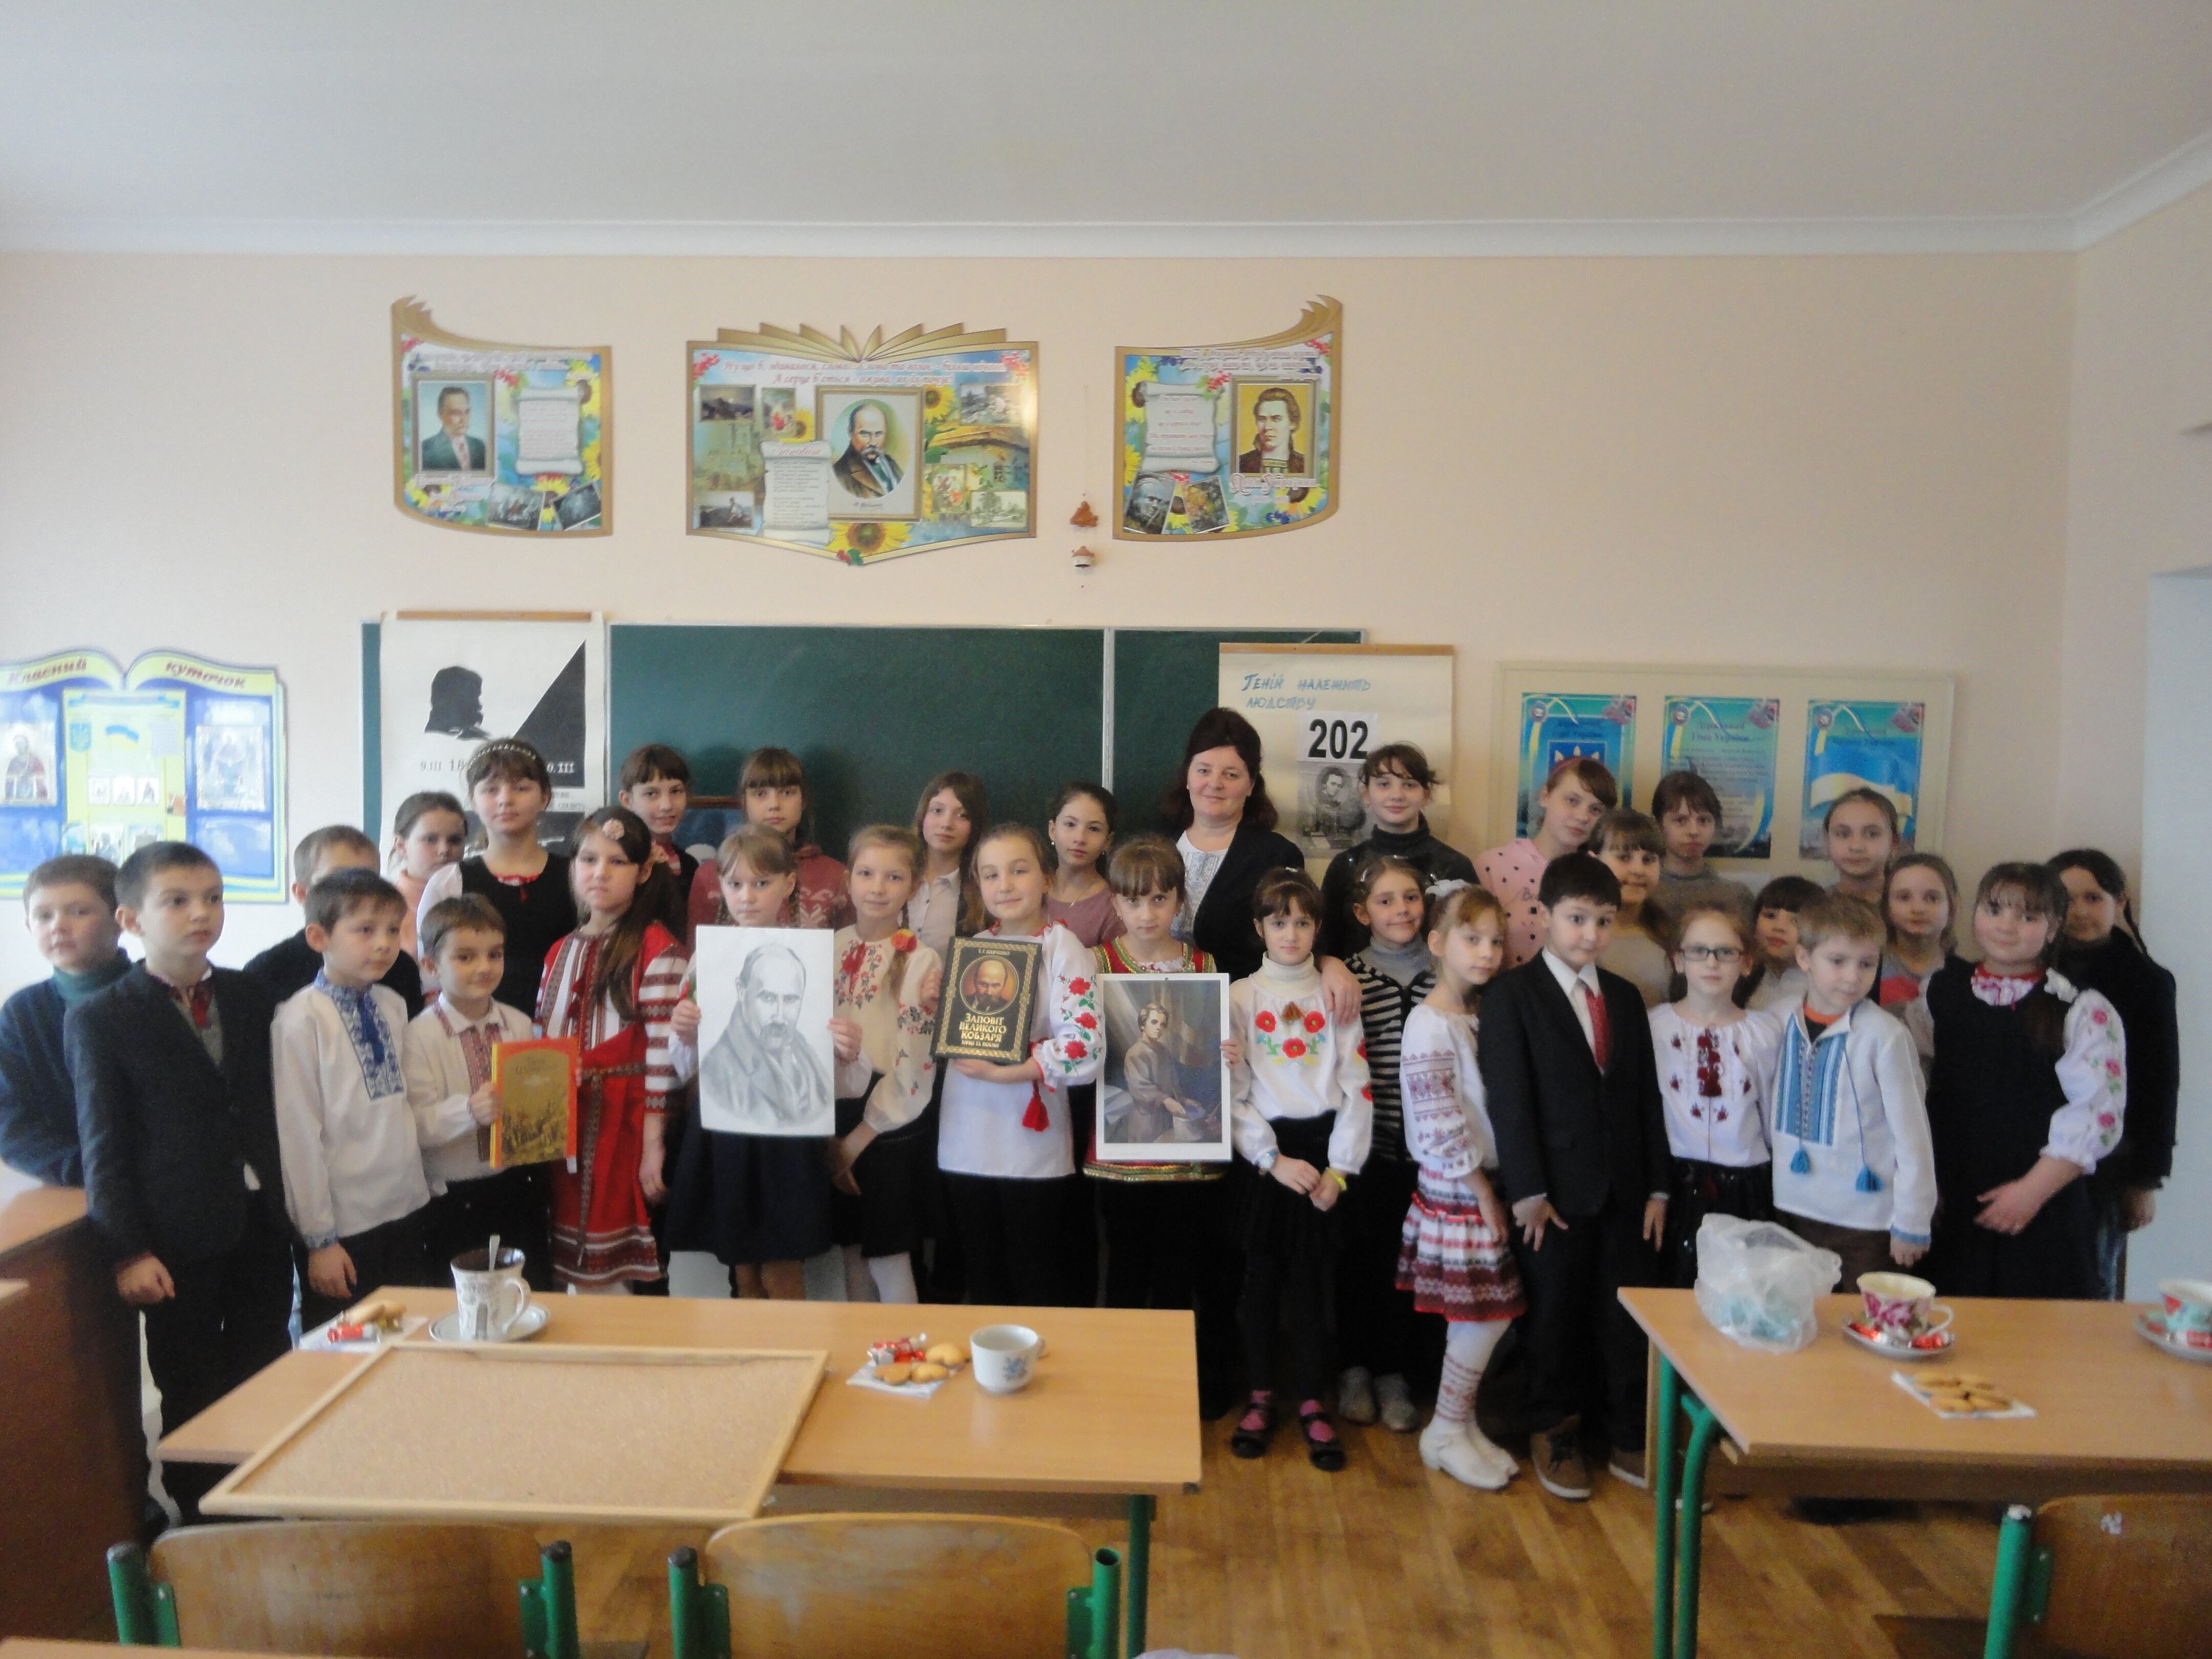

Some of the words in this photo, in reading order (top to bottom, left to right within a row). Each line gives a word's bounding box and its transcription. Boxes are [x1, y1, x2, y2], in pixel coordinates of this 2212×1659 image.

[1307, 718, 1369, 759] 202
[964, 1012, 1005, 1026] ЗАПОВІТ
[959, 1020, 1007, 1034] ВЕЛИКОГО
[961, 1030, 1003, 1043] КОБЗАРЯ
